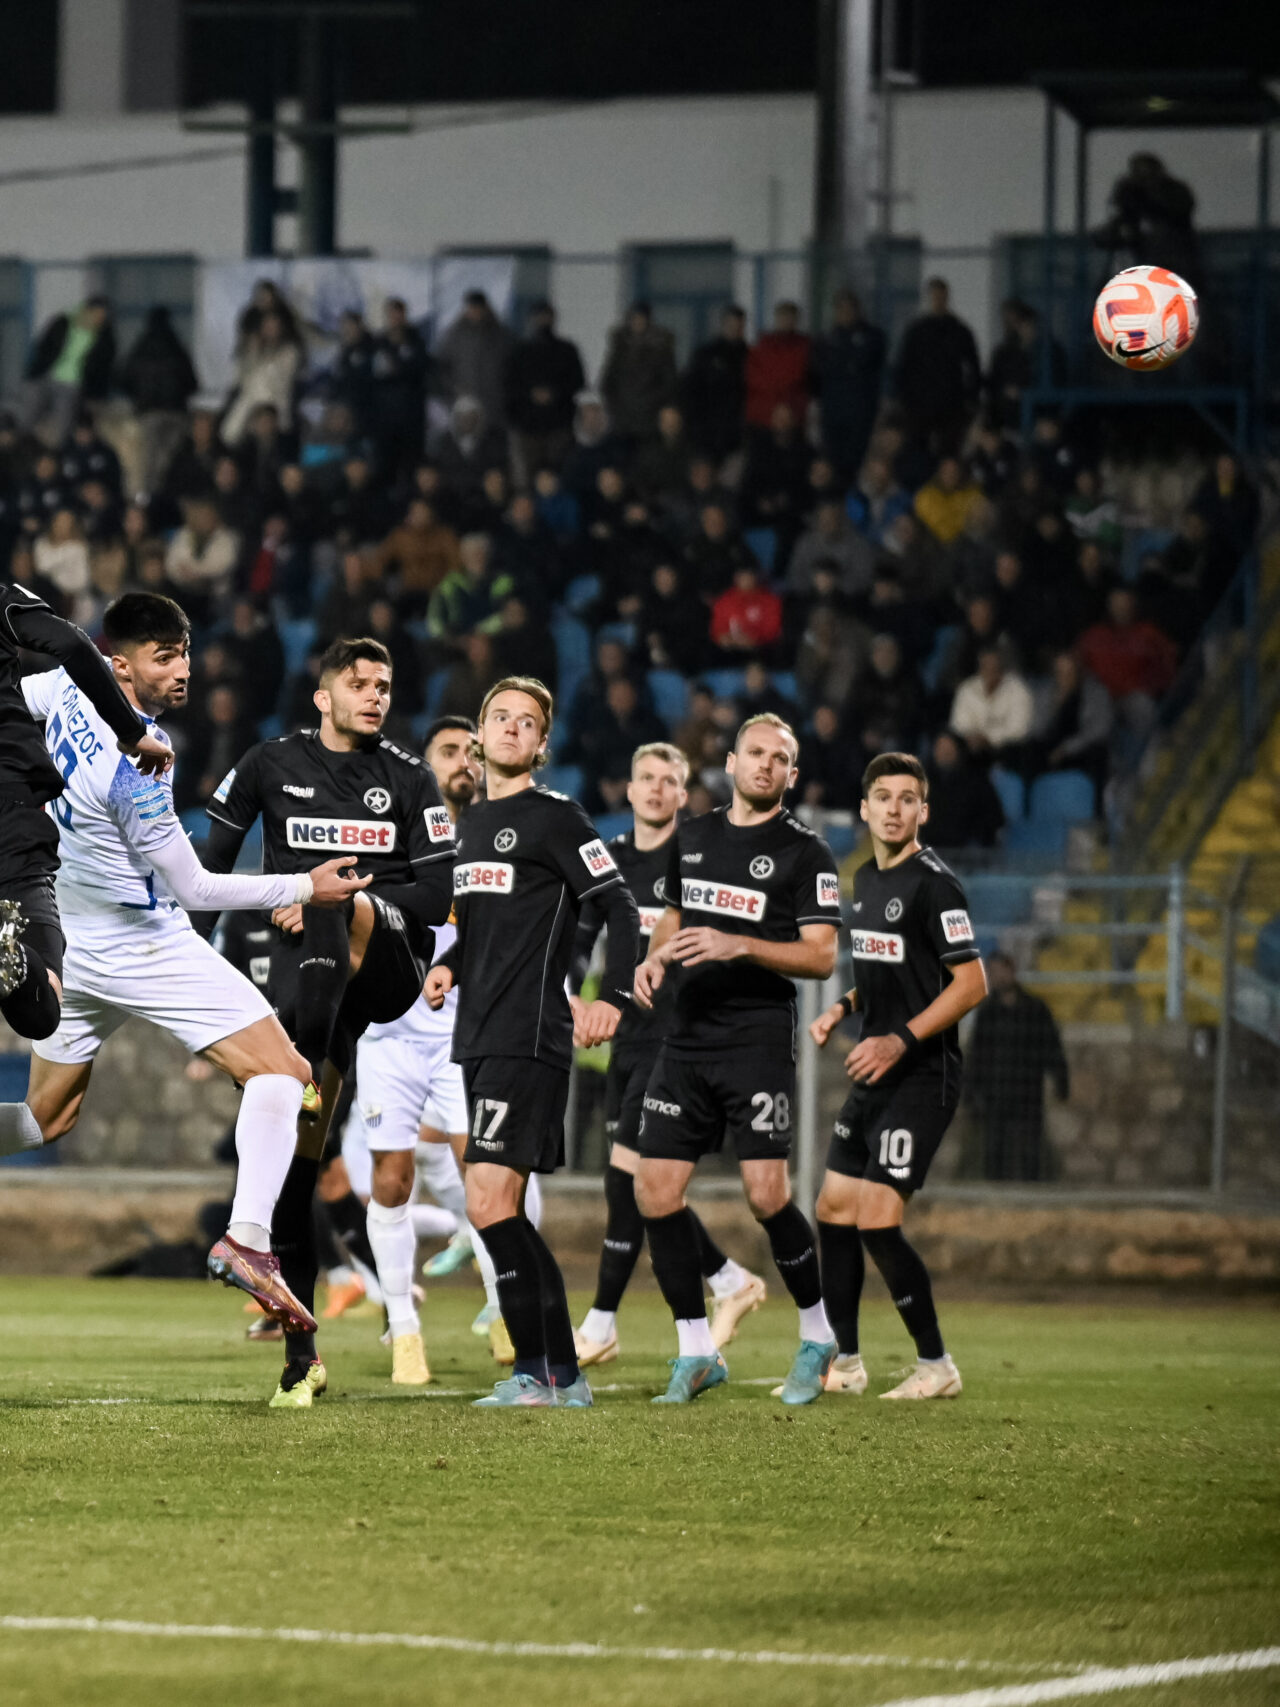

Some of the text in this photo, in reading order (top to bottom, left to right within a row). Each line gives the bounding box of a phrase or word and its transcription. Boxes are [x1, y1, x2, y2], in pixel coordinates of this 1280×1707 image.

[292, 823, 390, 847] NetBet
[454, 866, 507, 889] etBet
[852, 935, 898, 956] etBet
[472, 1098, 509, 1141] 17
[751, 1091, 790, 1132] 28
[878, 1128, 913, 1166] 10
